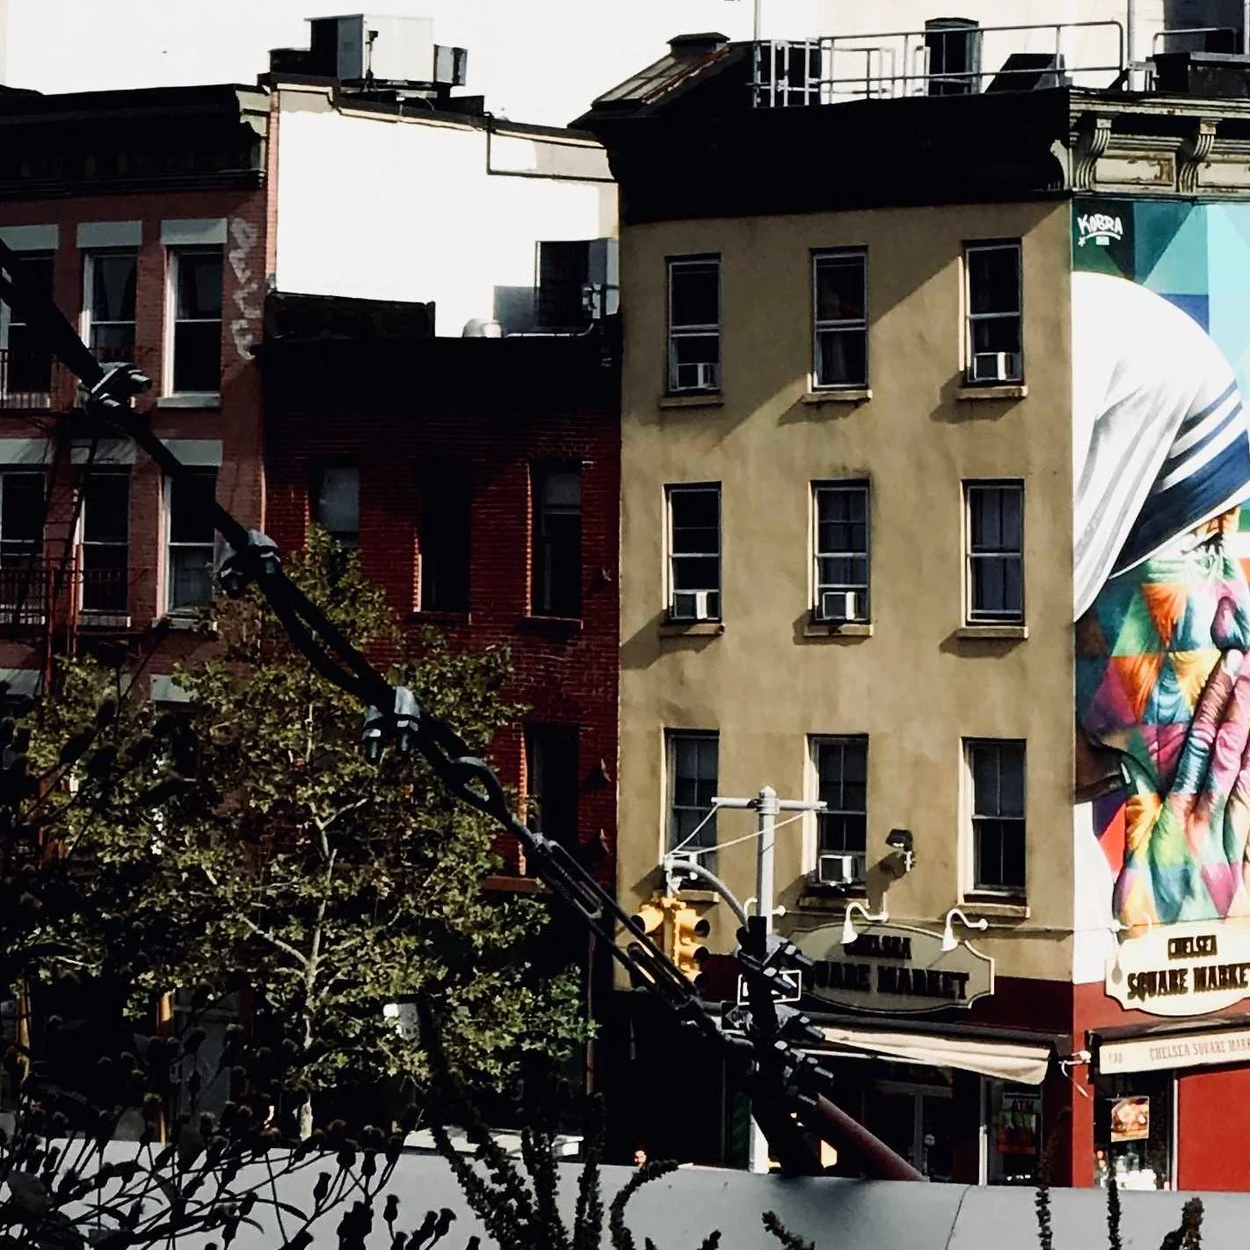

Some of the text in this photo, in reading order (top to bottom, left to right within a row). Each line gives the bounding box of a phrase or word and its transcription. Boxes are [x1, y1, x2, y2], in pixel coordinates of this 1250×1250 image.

[1077, 213, 1123, 235] KOBRA
[1168, 935, 1218, 960] CHELSEA
[877, 964, 970, 1000] MARKET
[1127, 968, 1188, 1002] SQUARE
[1149, 1044, 1190, 1061] CHELSEA
[1193, 1040, 1226, 1056] SQUARE
